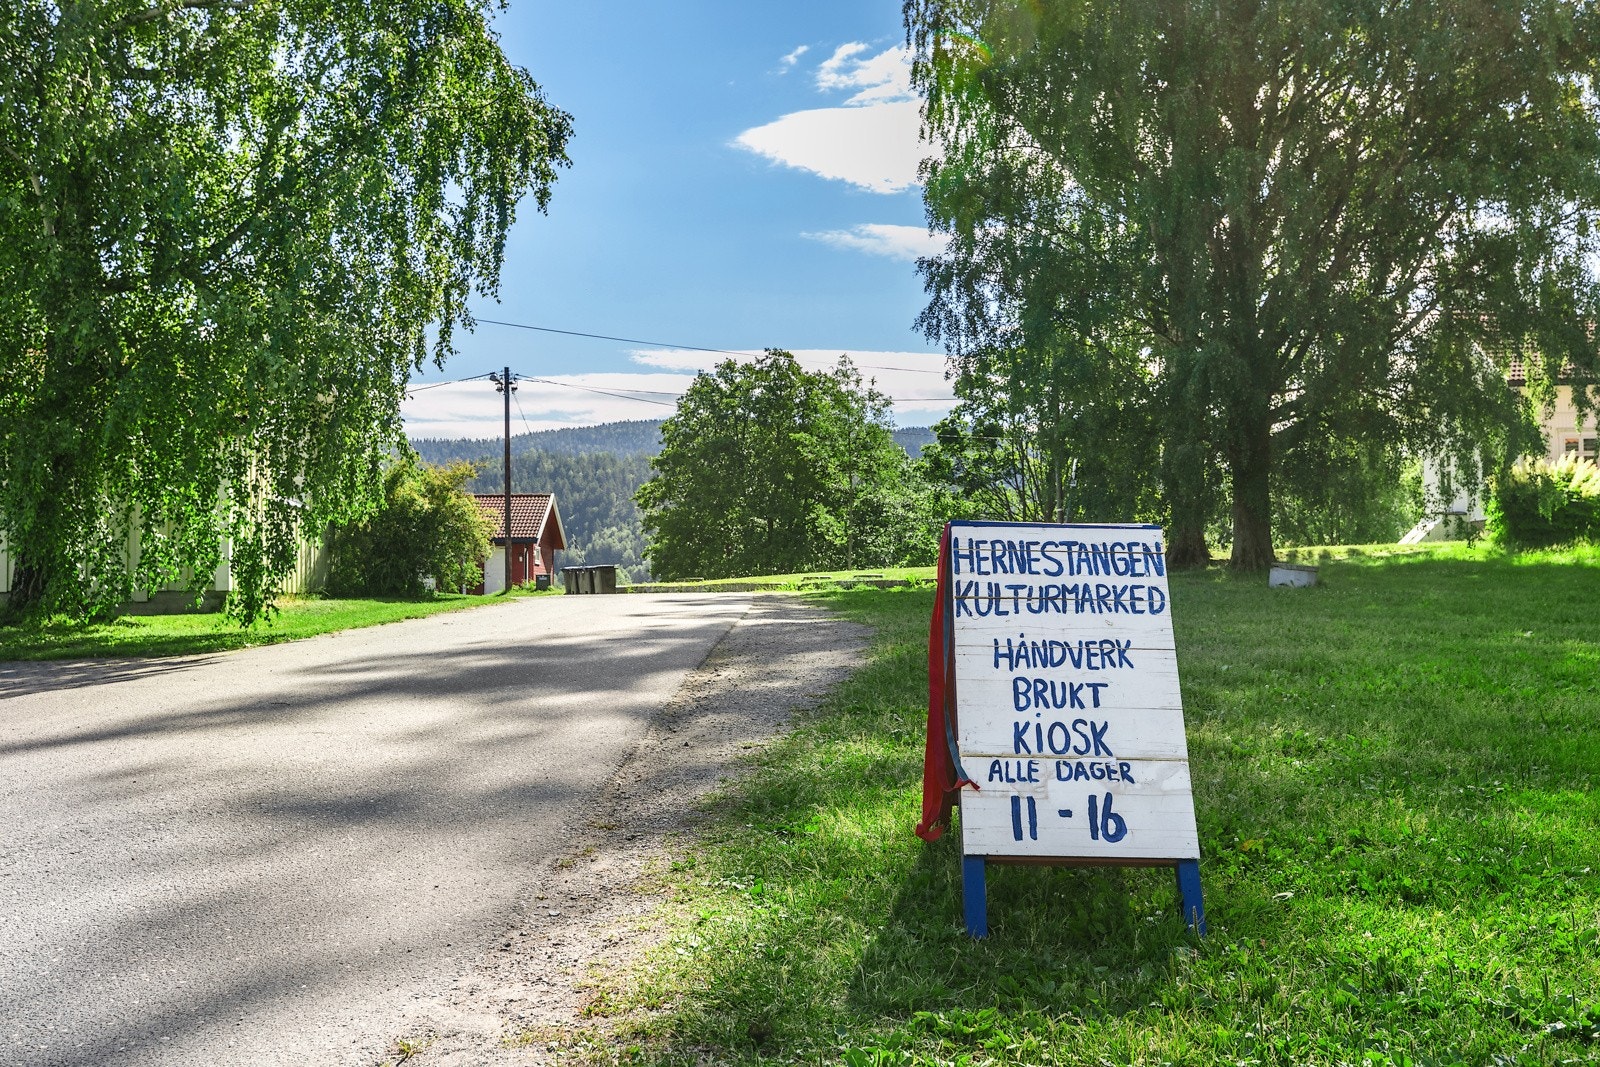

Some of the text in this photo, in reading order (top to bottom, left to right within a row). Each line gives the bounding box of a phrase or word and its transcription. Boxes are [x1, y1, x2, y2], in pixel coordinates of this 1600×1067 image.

[953, 537, 1164, 577] HERNESTANGEN
[955, 580, 1166, 617] KULTURMARKED
[993, 633, 1134, 672] HÅNDVERK
[1012, 676, 1109, 711] BRUKT
[988, 759, 1135, 784] ALLE DAGER
[1011, 796, 1038, 841] 11
[1088, 792, 1128, 843] 16
